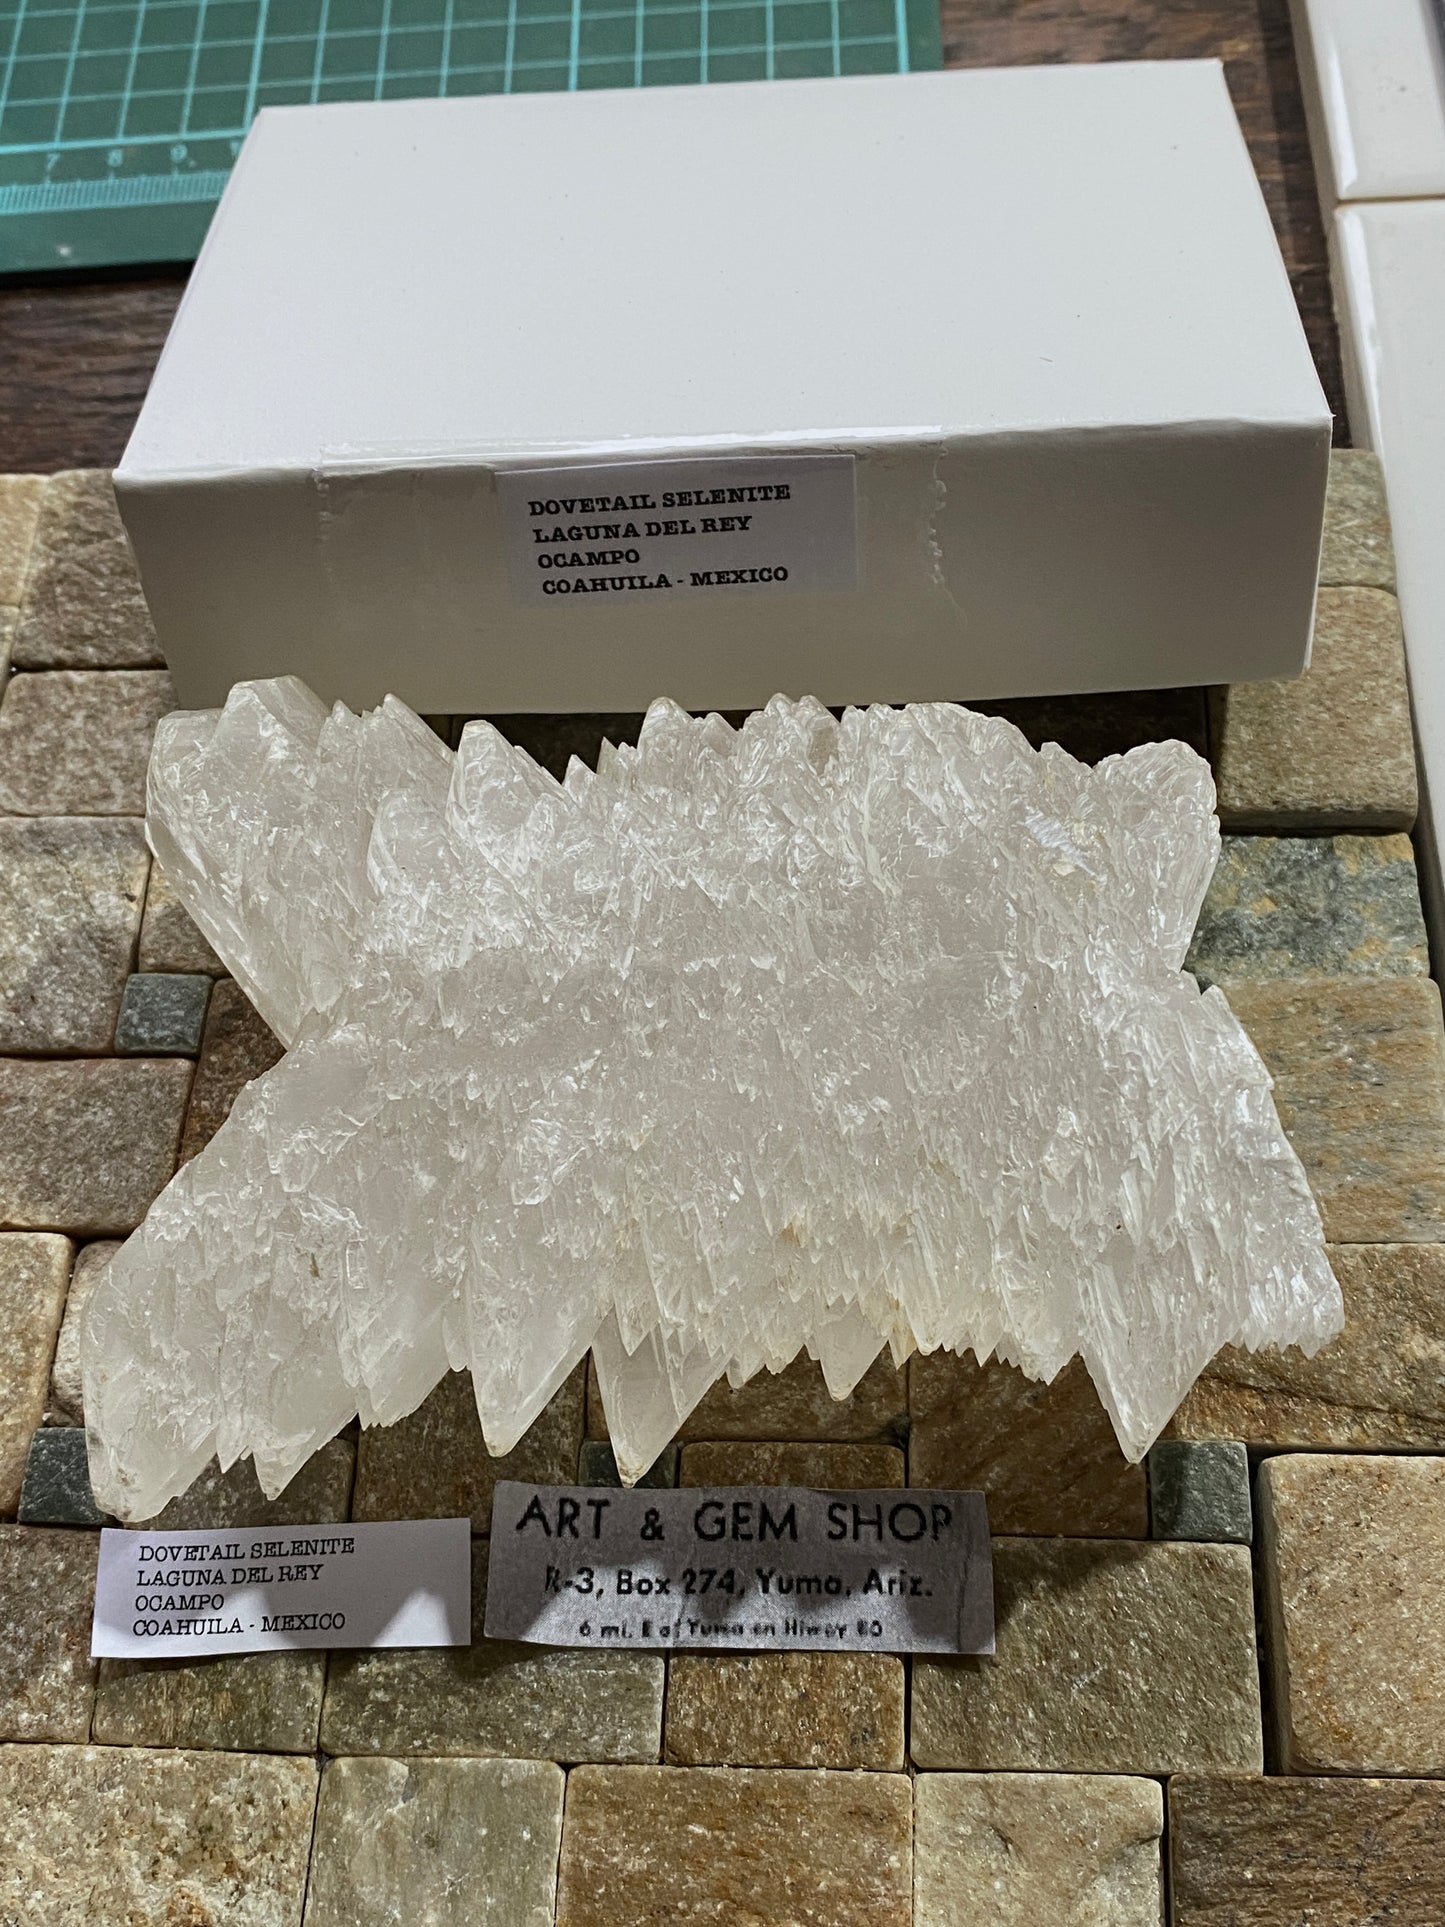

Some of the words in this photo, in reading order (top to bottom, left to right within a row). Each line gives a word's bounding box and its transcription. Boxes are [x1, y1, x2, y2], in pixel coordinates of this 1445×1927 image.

[47, 152, 61, 170] 7
[528, 494, 656, 516] DOVETAIL
[662, 484, 791, 507] SELENITE
[533, 522, 640, 543] LAGUNA
[645, 519, 696, 537] DEL
[701, 515, 752, 533] REY
[537, 549, 640, 569] OCAMPO
[542, 573, 672, 595] COAHUILA
[690, 566, 789, 587] MEXICO
[515, 1494, 610, 1539] ART
[639, 1507, 665, 1542] &
[694, 1501, 798, 1543] GEM
[827, 1502, 952, 1543] SHOP
[138, 1543, 246, 1563] DOVETAIL
[250, 1537, 355, 1559] SELENITE
[136, 1568, 227, 1587] LAGUNA
[231, 1566, 274, 1585] DEL
[277, 1564, 324, 1583] REY
[545, 1565, 604, 1600] R-3,
[617, 1568, 671, 1595] Box
[682, 1568, 746, 1599] 274,
[863, 1567, 932, 1596] Ariz.
[135, 1593, 225, 1612] OCAMPO
[132, 1617, 244, 1637] COAHUILA
[260, 1612, 346, 1633] MEXICO
[579, 1620, 591, 1637] 6
